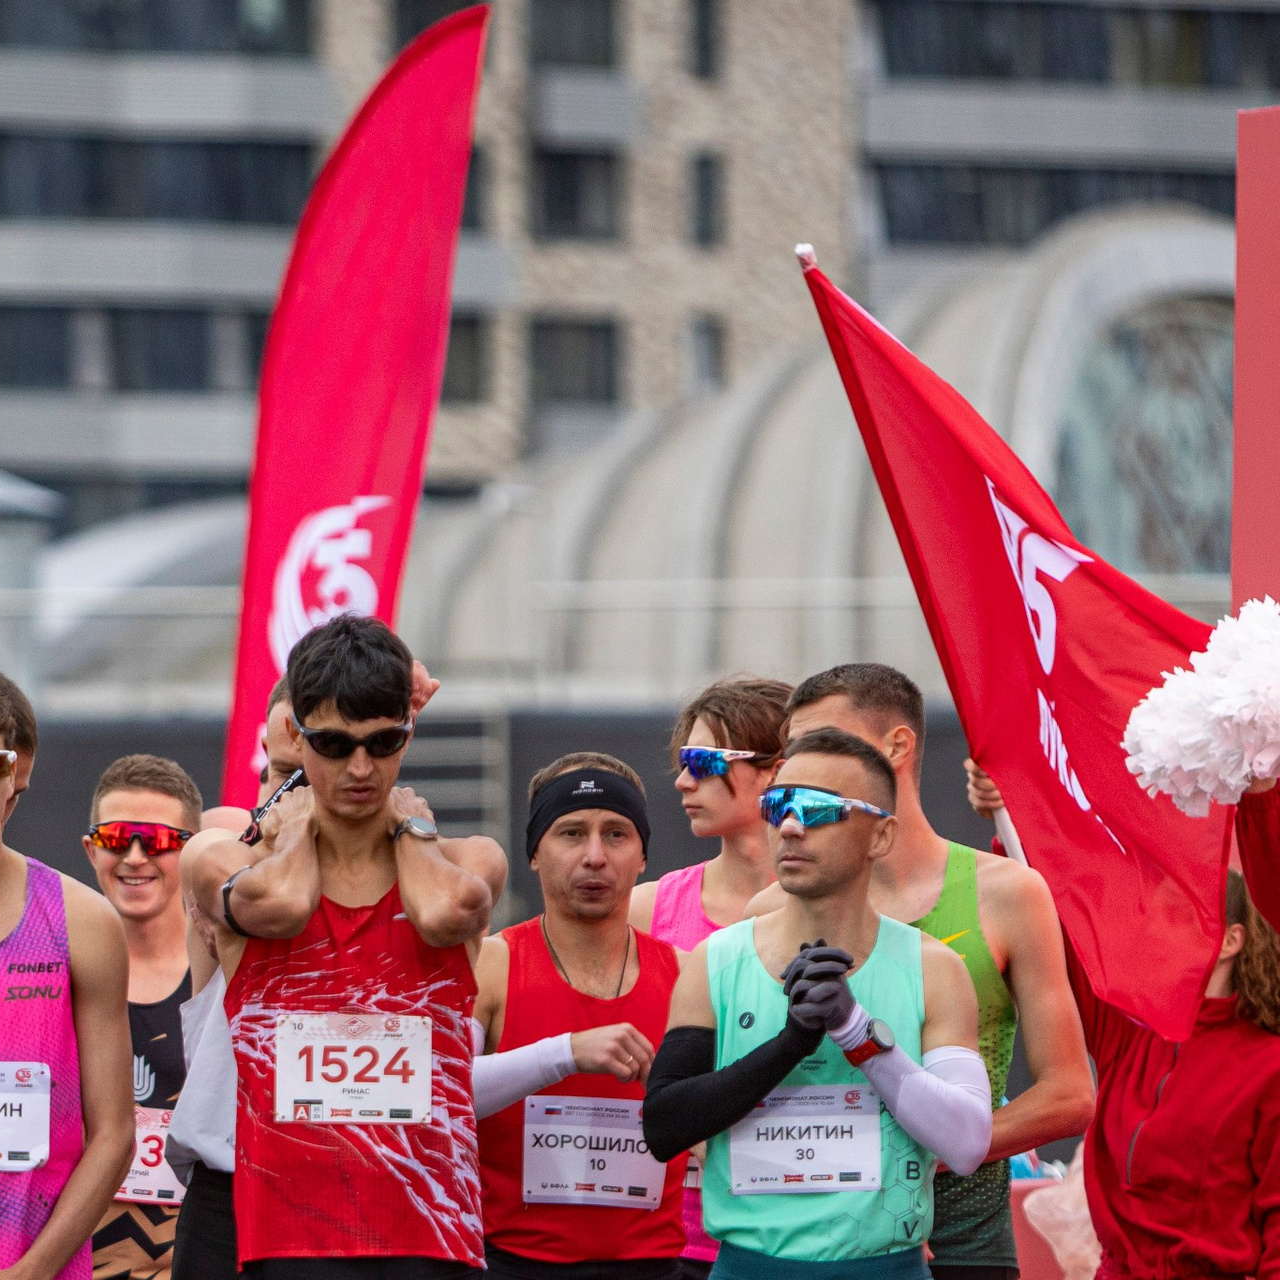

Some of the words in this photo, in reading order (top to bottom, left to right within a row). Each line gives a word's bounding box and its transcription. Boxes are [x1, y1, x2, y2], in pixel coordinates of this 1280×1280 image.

[8, 962, 63, 974] FONBET
[4, 985, 63, 1001] SONU
[298, 1045, 415, 1083] 1524
[757, 1125, 853, 1141] НИКИТИН
[532, 1133, 651, 1154] ХОРОШИЛО
[796, 1148, 815, 1160] 30
[590, 1158, 606, 1170] 10
